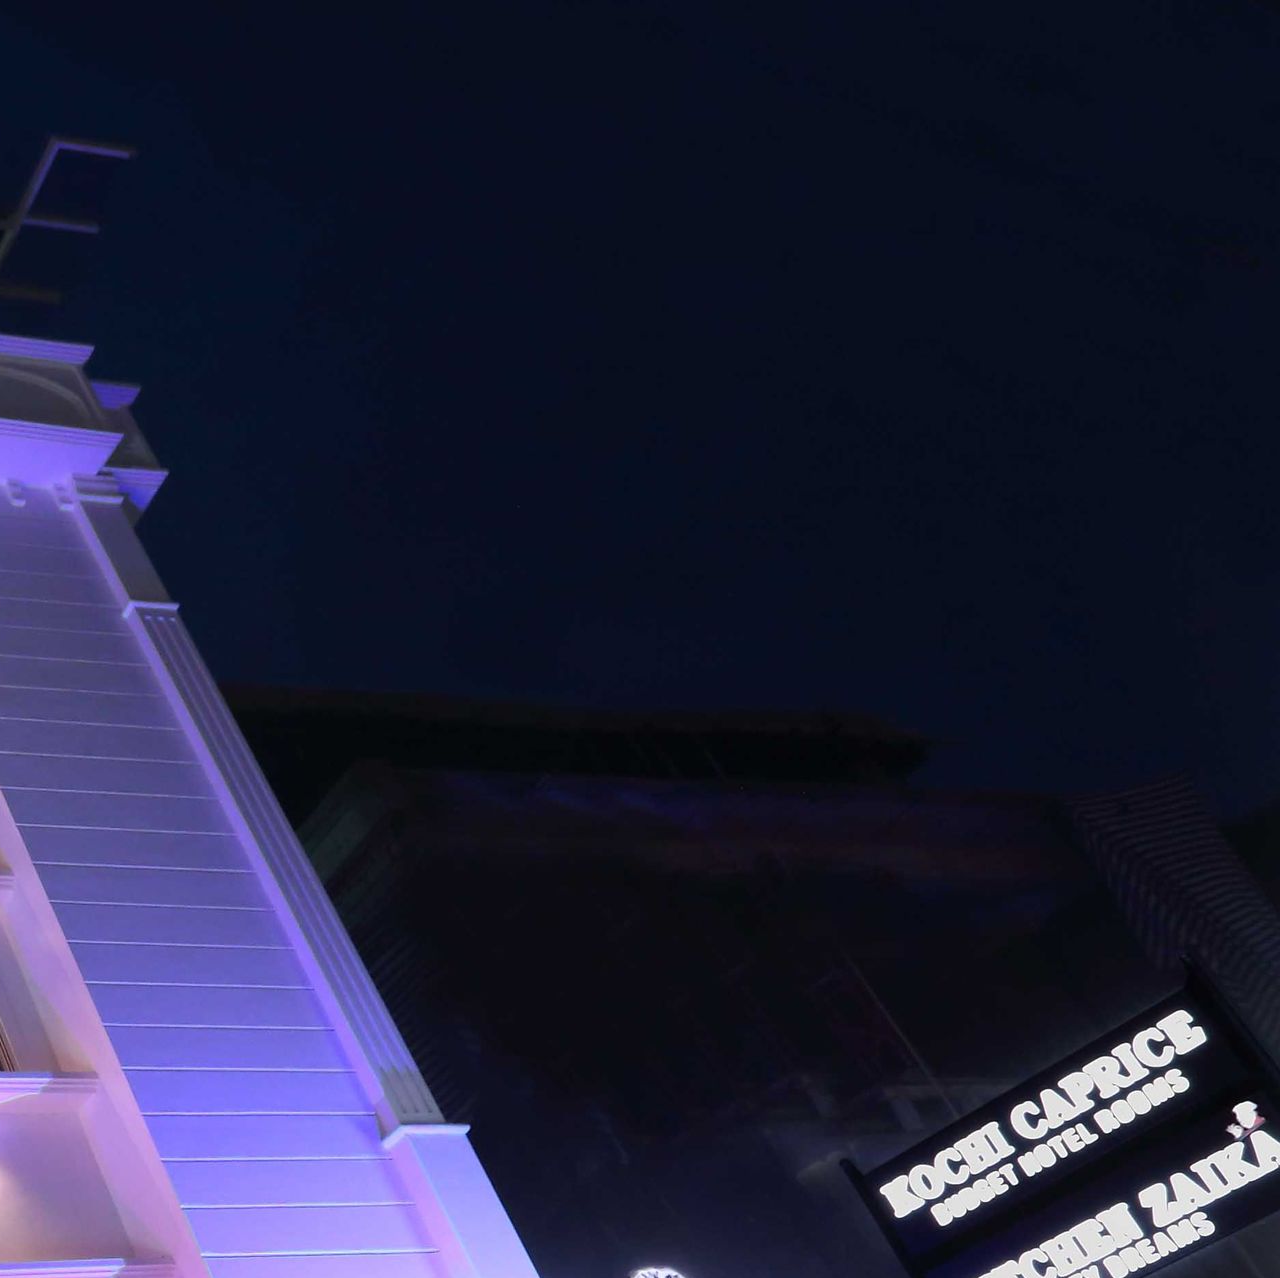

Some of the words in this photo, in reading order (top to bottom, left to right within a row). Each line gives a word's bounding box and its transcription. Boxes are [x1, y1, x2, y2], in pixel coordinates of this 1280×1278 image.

[879, 1121, 1016, 1219] KOCHI
[1010, 1009, 1207, 1140] CAPRICE
[930, 1163, 1019, 1227] BUDGET
[1017, 1122, 1099, 1177] HOTEL
[1093, 1068, 1190, 1134] ROOMS
[1137, 1130, 1280, 1228] ZAIKA
